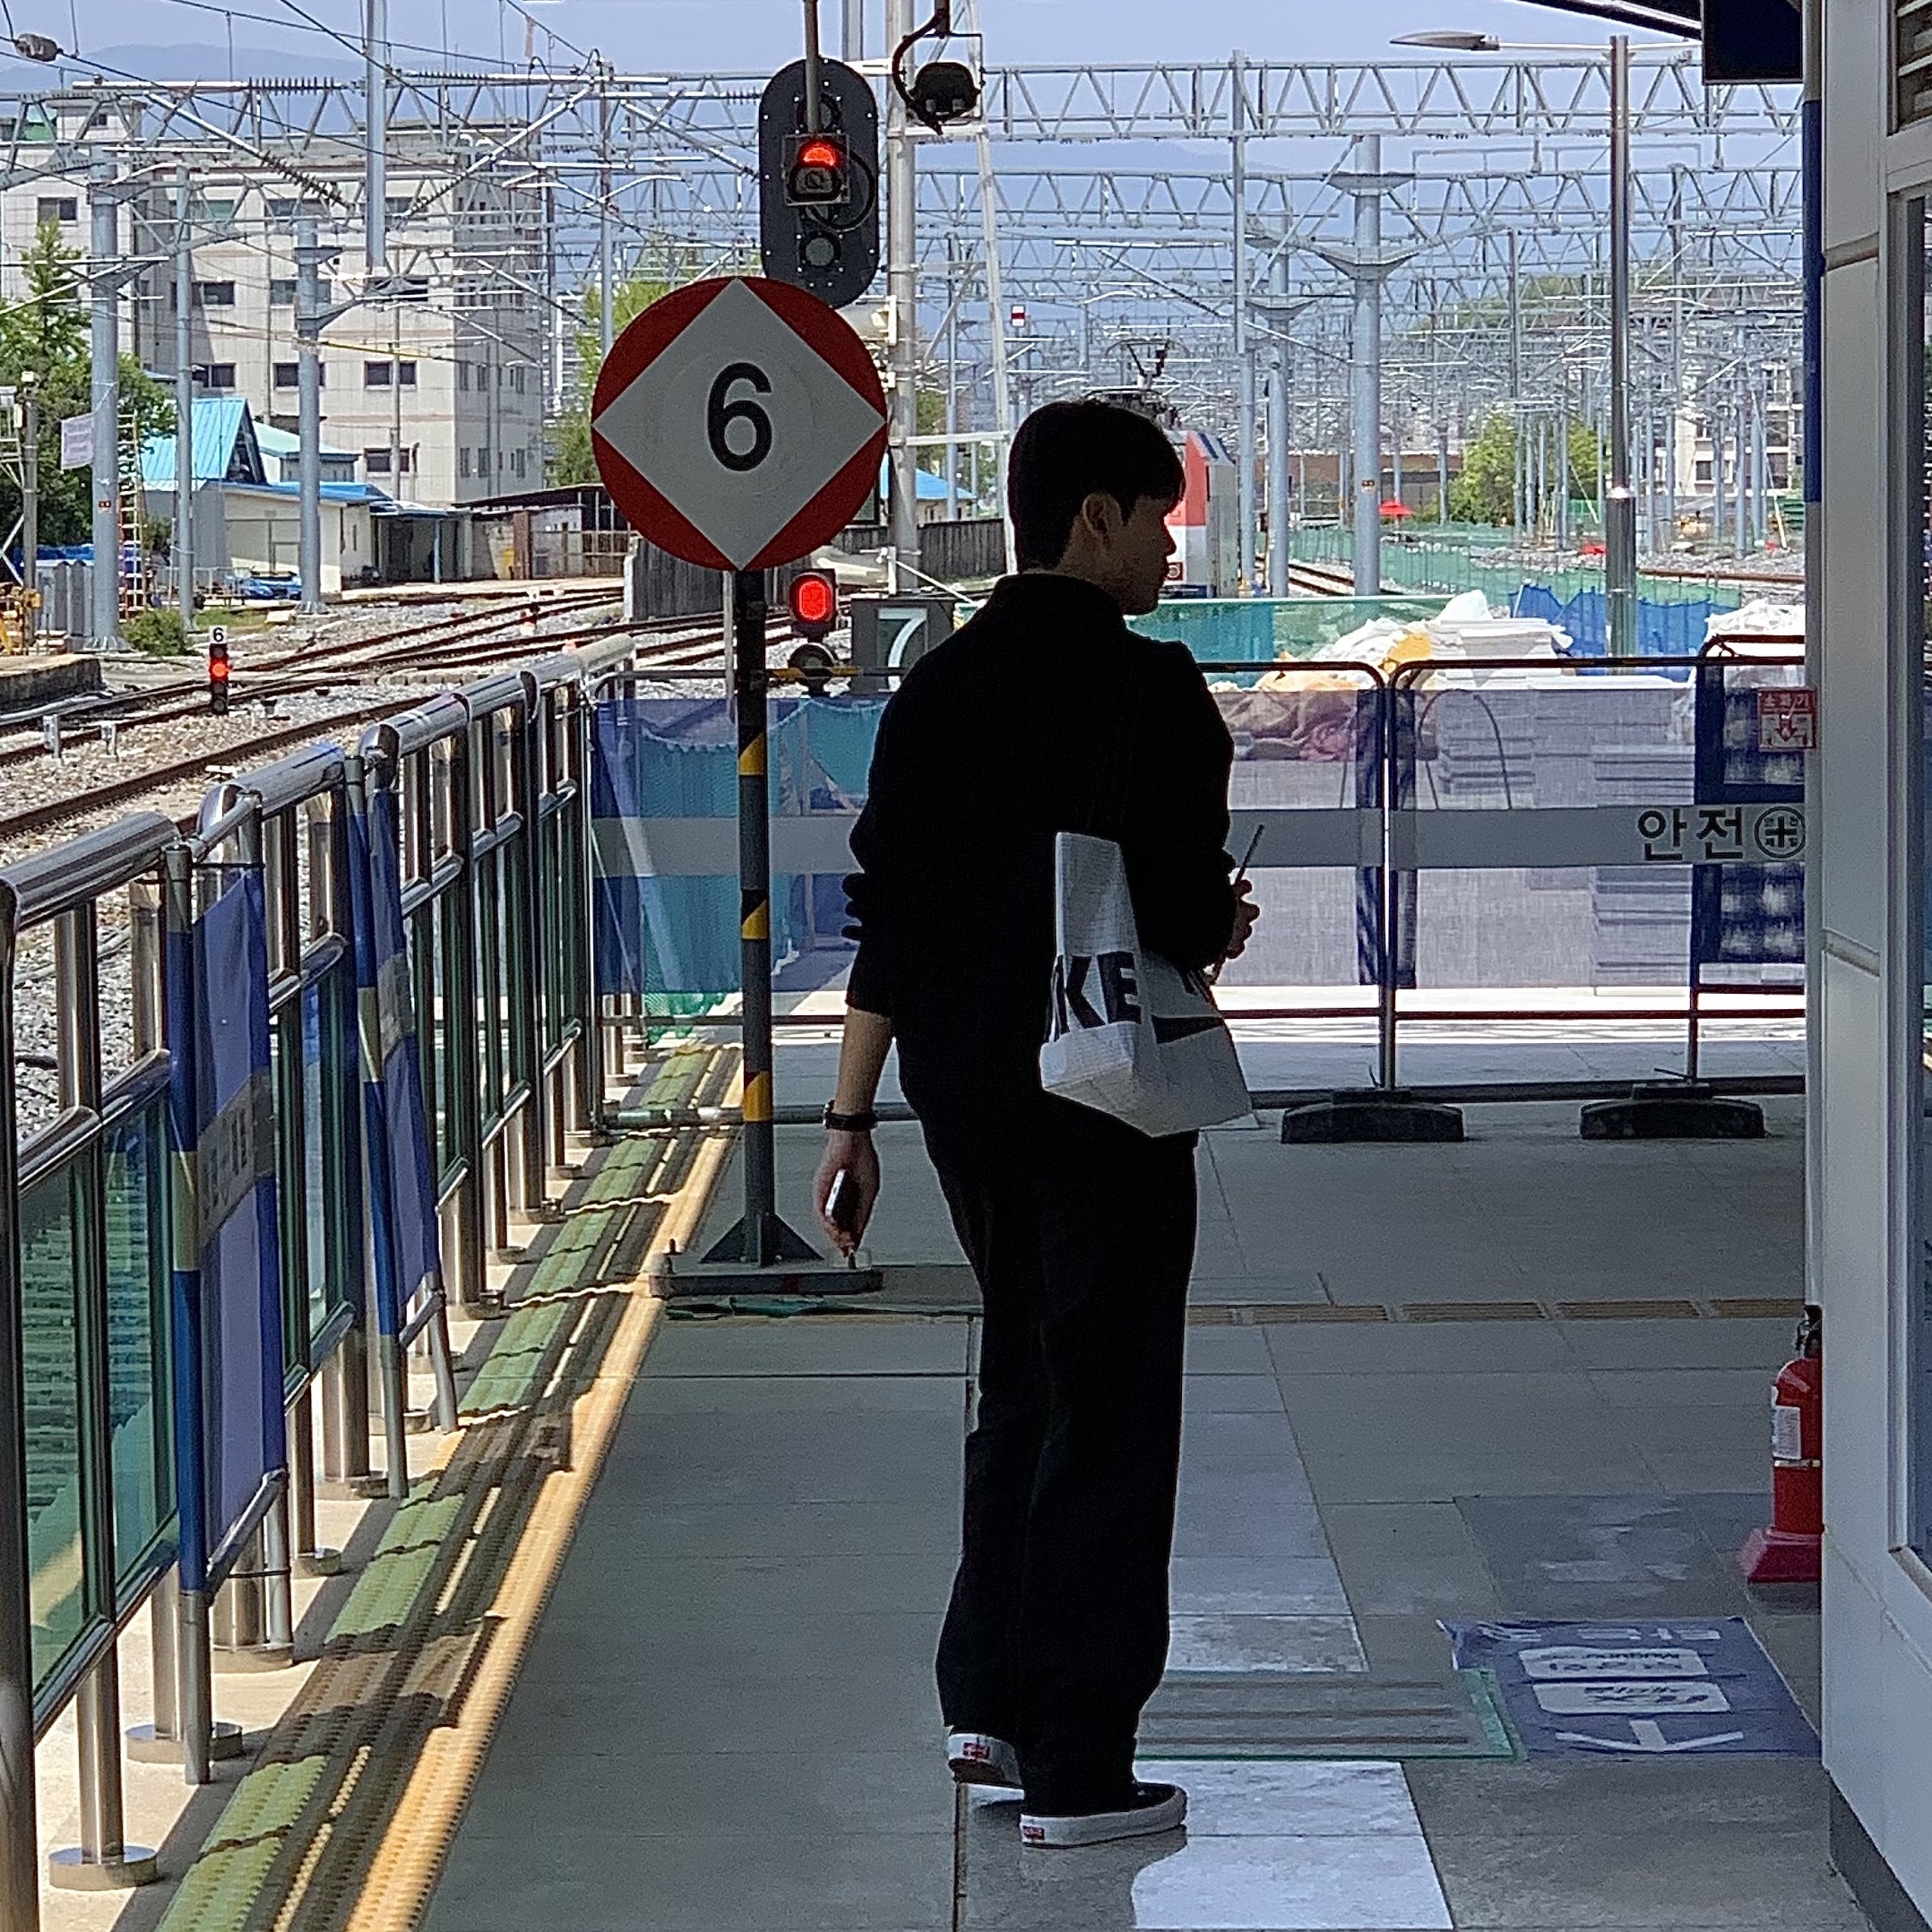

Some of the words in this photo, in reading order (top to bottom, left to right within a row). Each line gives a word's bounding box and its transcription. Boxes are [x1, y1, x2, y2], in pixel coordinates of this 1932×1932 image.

[707, 362, 772, 471] 6
[213, 627, 223, 642] 6
[878, 608, 927, 693] 7
[1638, 807, 1743, 861] 안전
